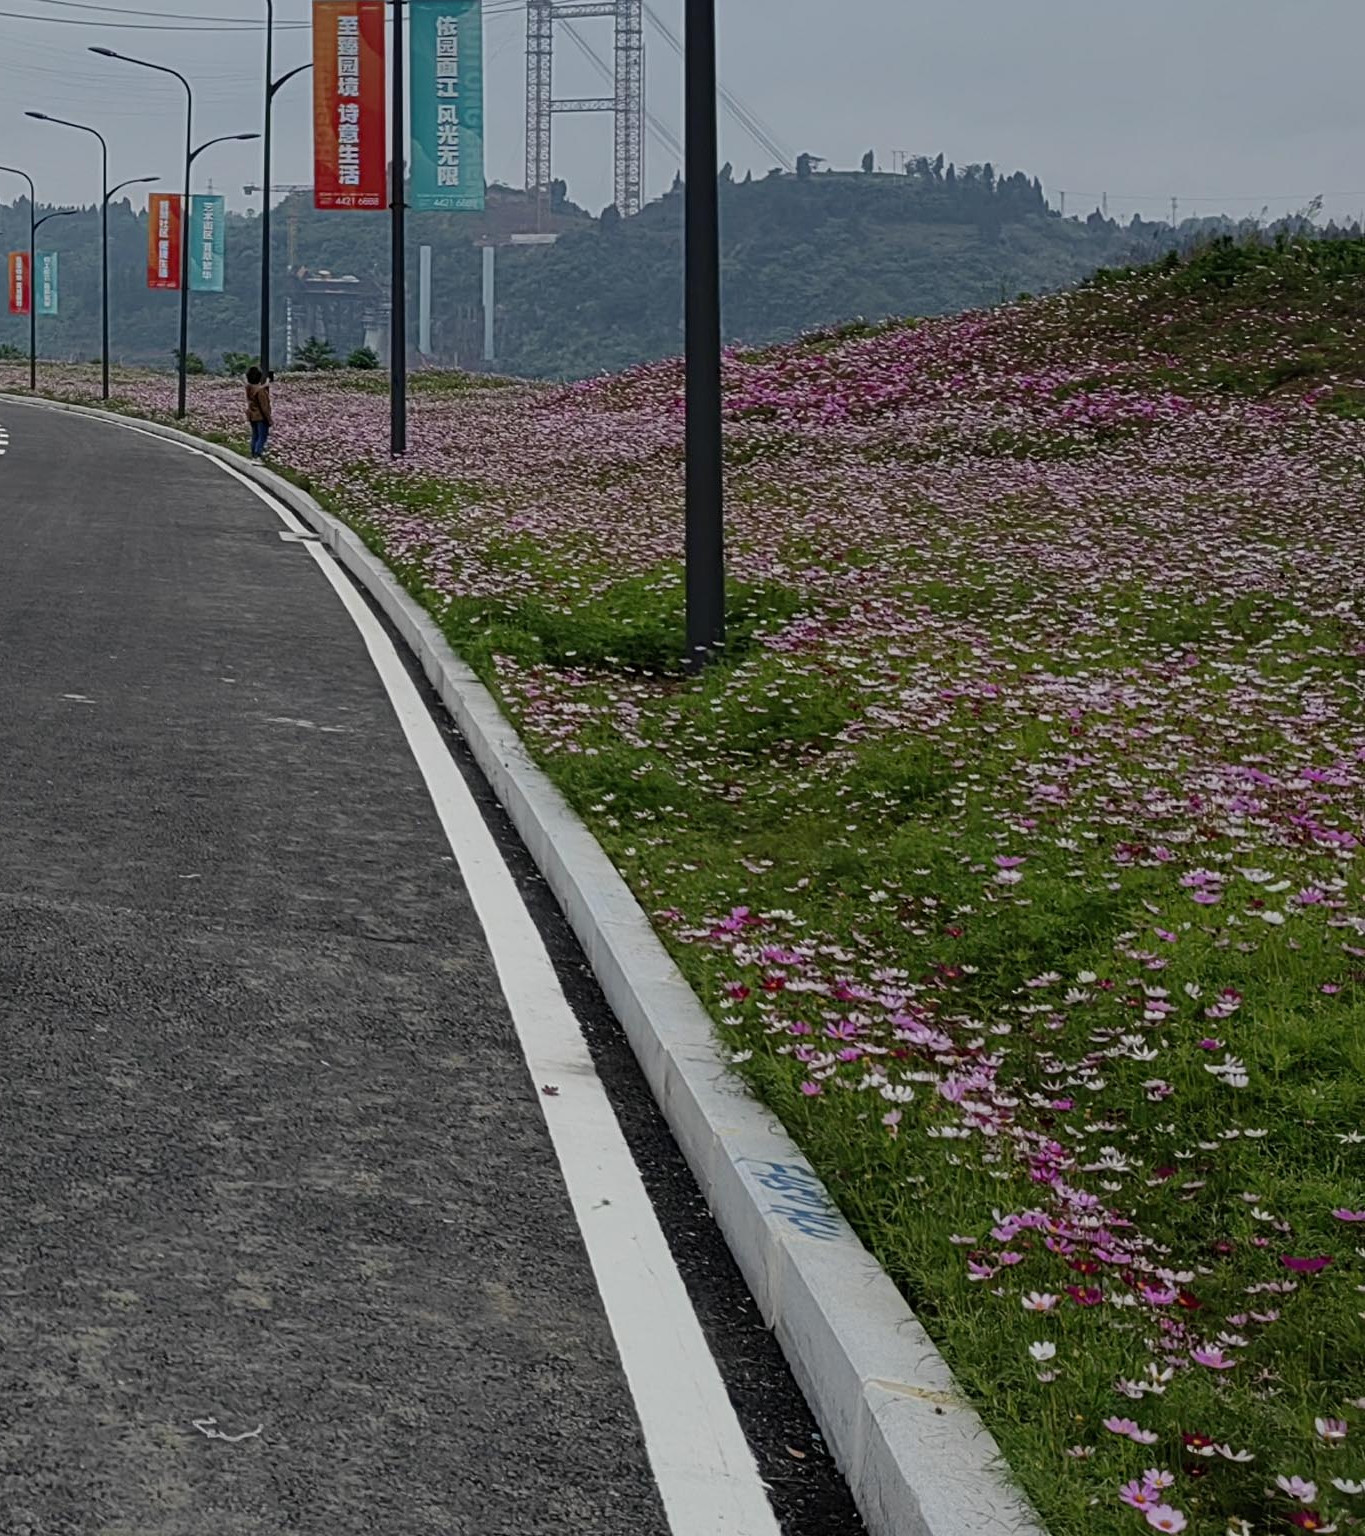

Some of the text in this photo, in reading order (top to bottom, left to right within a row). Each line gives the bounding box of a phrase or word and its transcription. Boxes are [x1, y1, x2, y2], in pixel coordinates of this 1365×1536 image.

[336, 103, 360, 185] 诗意生活
[436, 104, 459, 186] 风光无限
